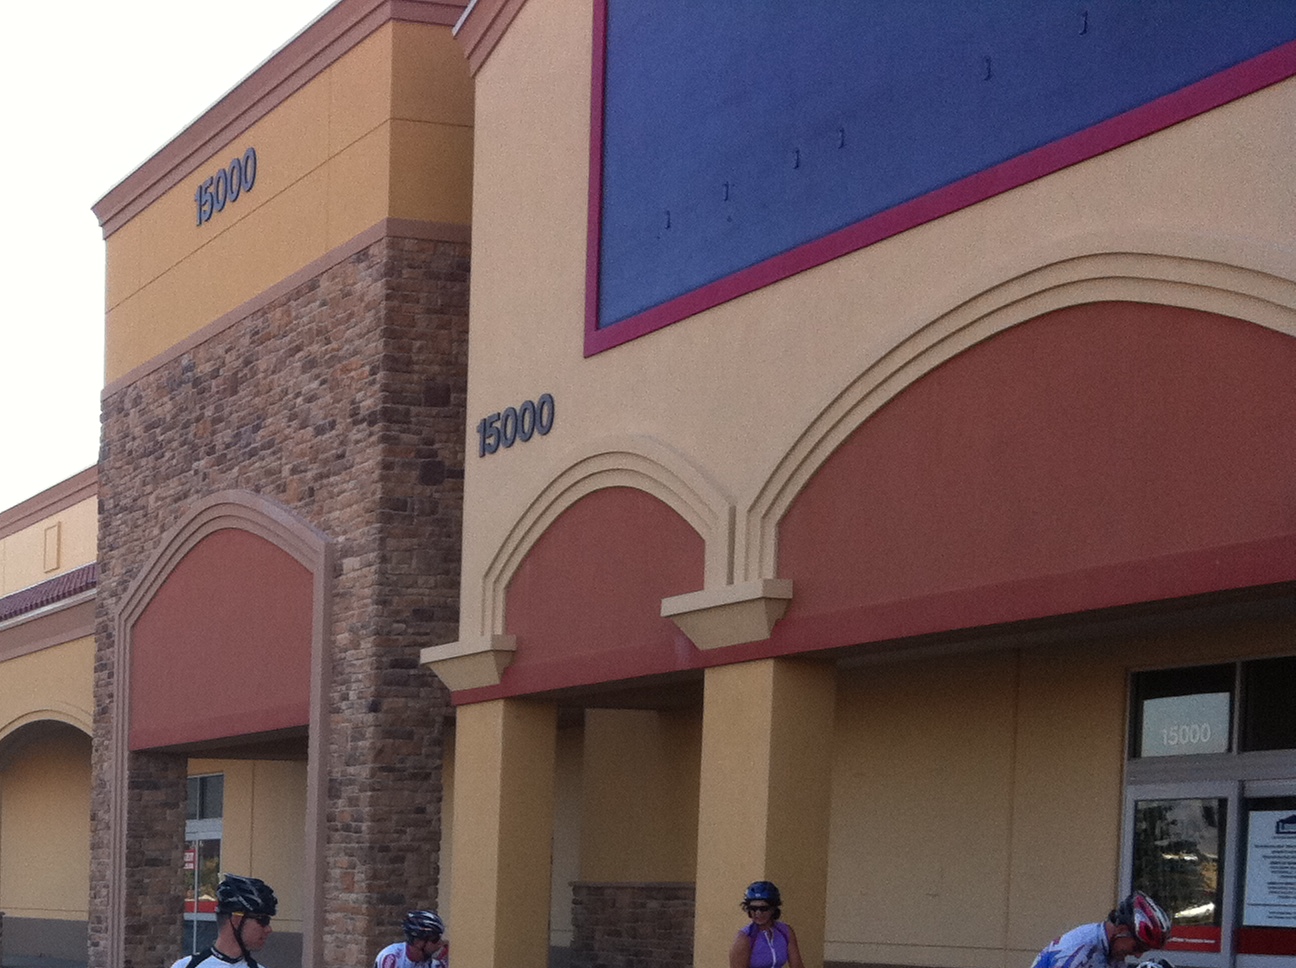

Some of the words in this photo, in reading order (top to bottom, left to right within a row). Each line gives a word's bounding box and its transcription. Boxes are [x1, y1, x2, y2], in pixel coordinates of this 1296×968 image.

[195, 147, 257, 227] 15000
[477, 393, 555, 458] 15000
[1163, 723, 1211, 745] 15000
